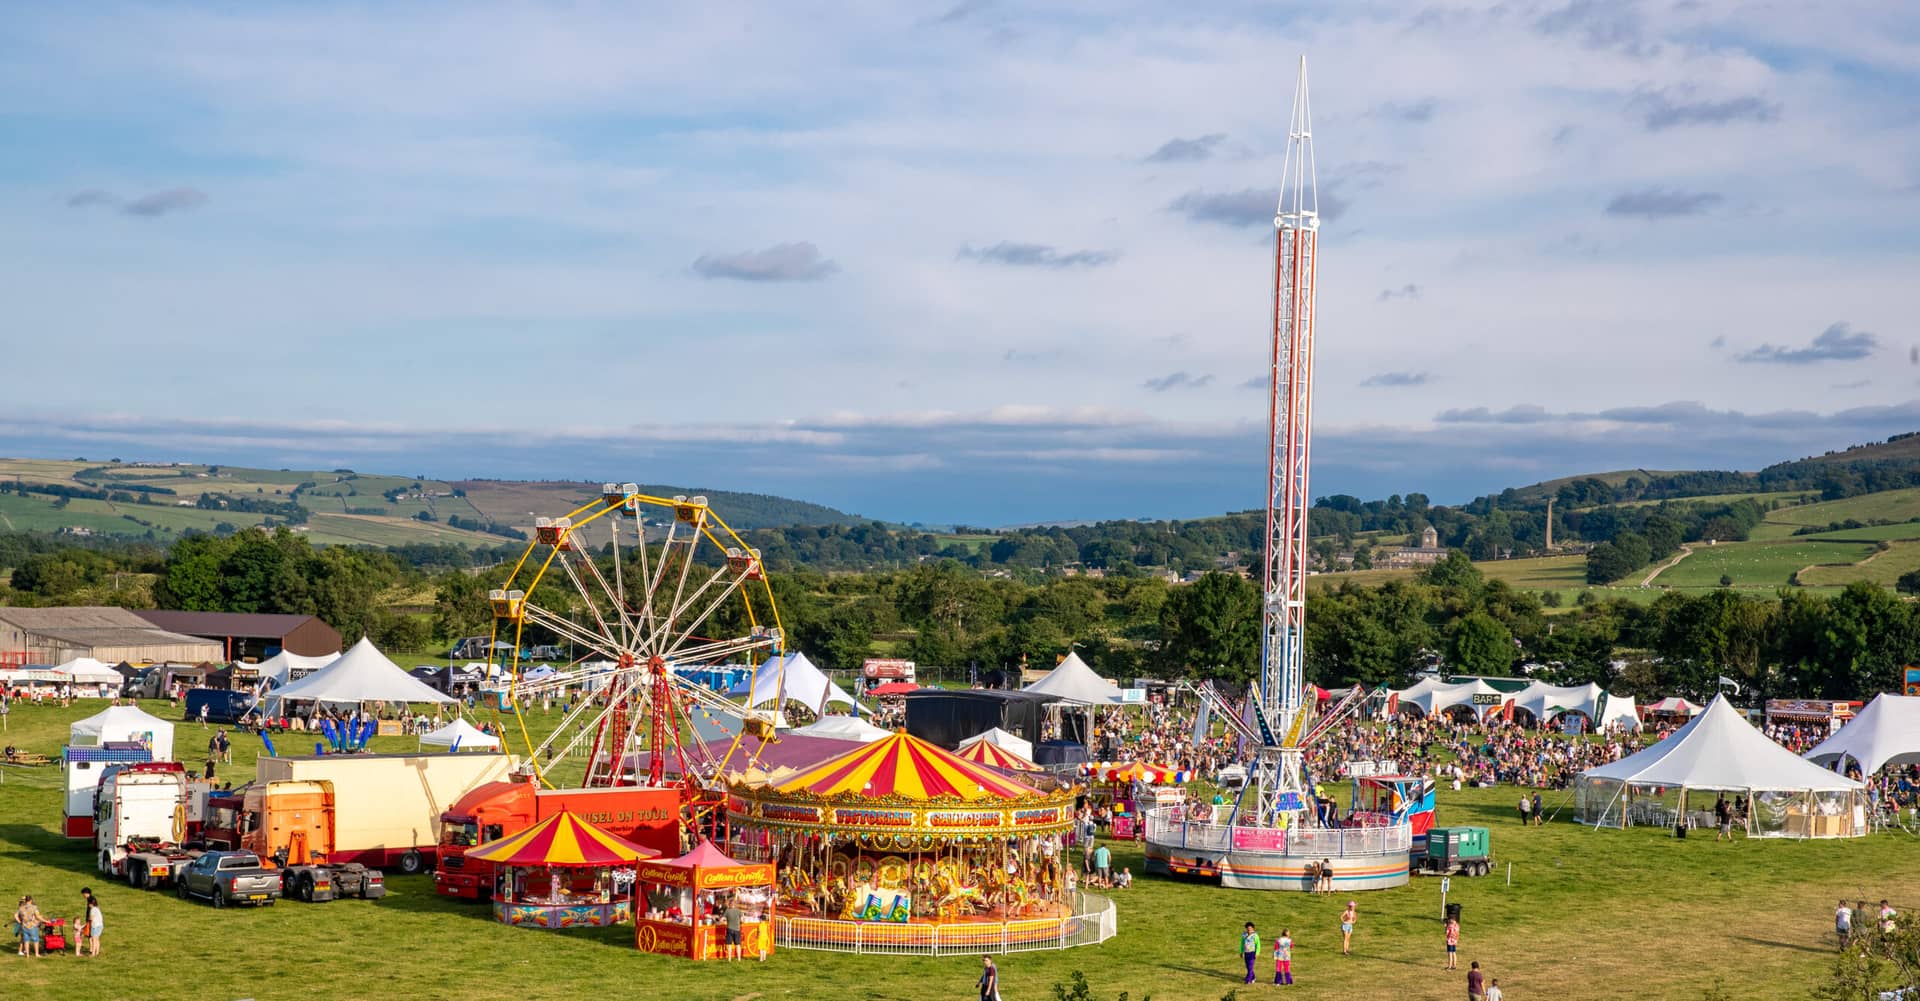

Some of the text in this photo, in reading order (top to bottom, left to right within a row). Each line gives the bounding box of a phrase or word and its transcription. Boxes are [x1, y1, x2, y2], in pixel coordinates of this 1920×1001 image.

[1473, 695, 1493, 704] BAR
[617, 811, 634, 822] ON
[638, 808, 668, 821] TOUR
[835, 809, 912, 826] VICTORIAN
[930, 811, 1000, 827] GALLOPING
[642, 868, 664, 880] Cotton
[664, 870, 689, 886] Candy
[704, 870, 768, 885] Cotton Candy
